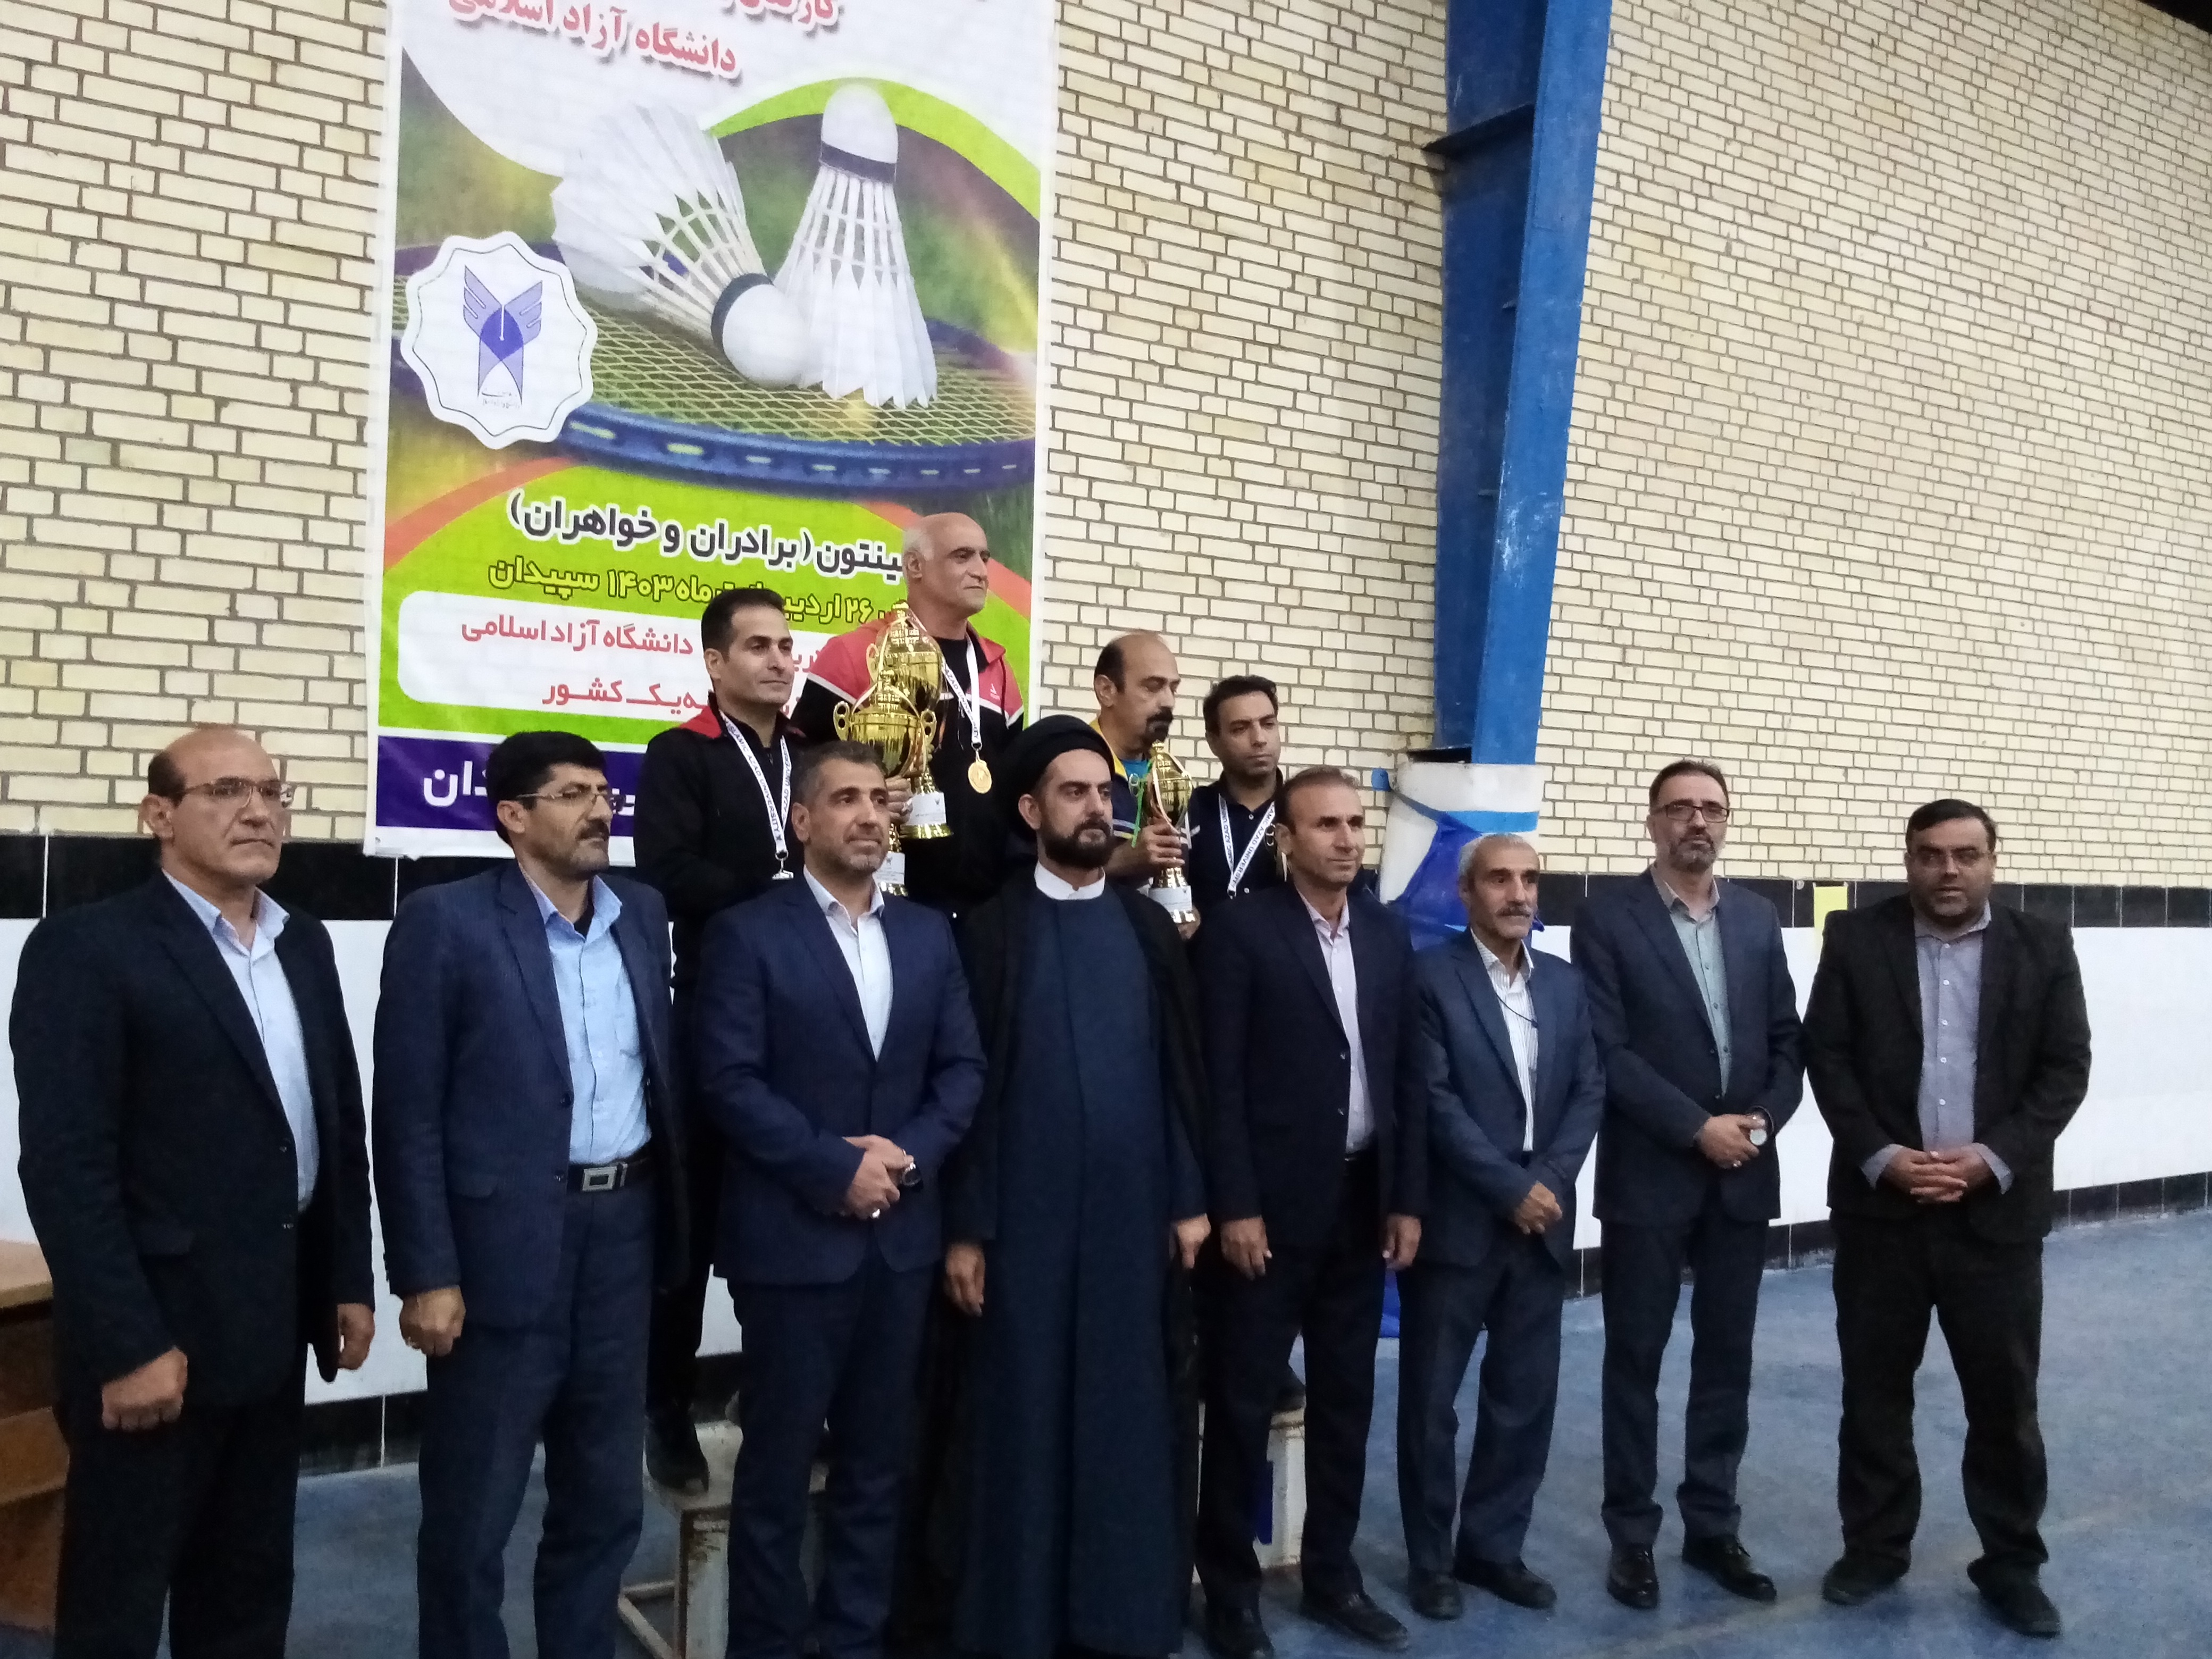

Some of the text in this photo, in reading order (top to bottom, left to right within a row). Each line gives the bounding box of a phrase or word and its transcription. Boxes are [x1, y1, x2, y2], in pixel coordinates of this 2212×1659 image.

[563, 4, 627, 49] آزاد
[635, 21, 736, 72] دانشگاه
[510, 492, 657, 547] خواهران)
[663, 524, 681, 553] و
[488, 555, 600, 601] سپیدان
[816, 542, 903, 581] ینتون
[607, 568, 675, 602] ۱۴۰۳
[784, 592, 843, 625] اردیب
[461, 614, 694, 655] دانشگاه آزاد اسلامی
[542, 677, 623, 706] کشور
[944, 668, 979, 740] AZAD UNIVEITY
[748, 754, 761, 776] AZAD
[759, 778, 780, 832] UNIVERSITY
[1231, 805, 1275, 889] AMIC AZAD UNIVERSITY
